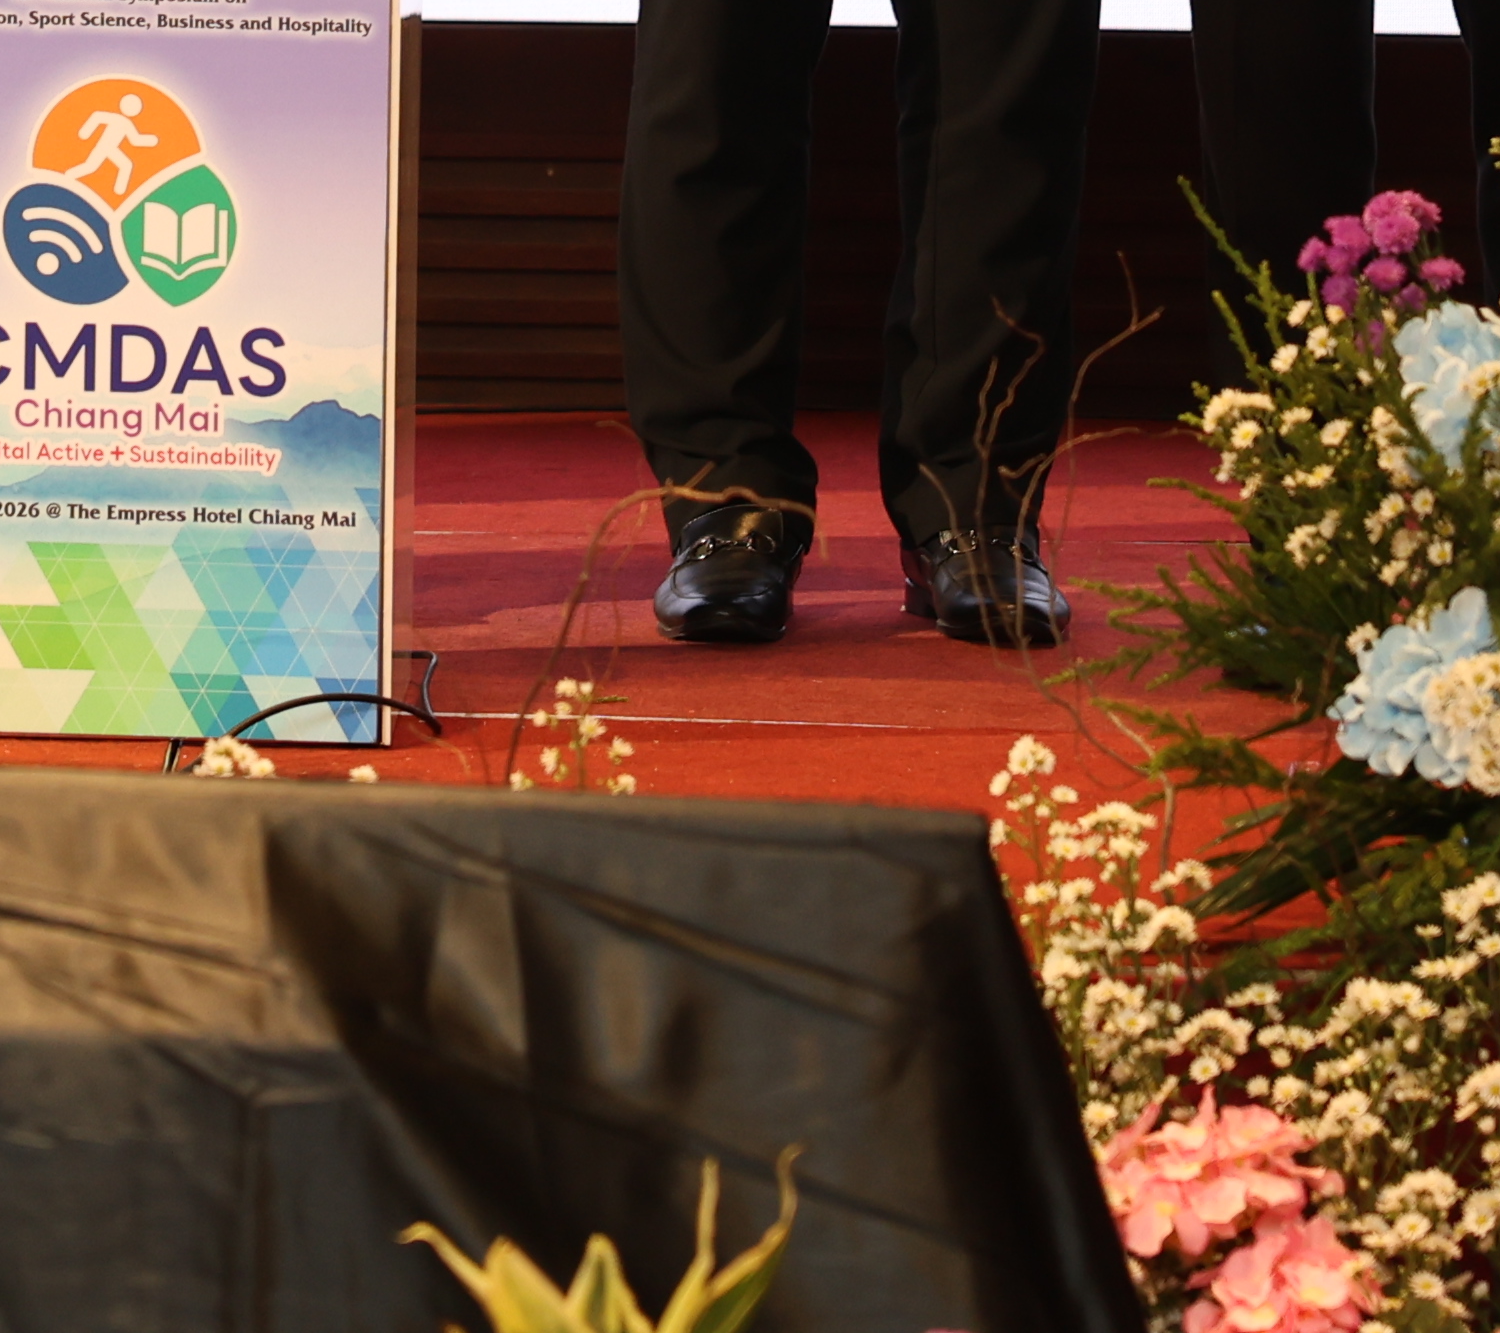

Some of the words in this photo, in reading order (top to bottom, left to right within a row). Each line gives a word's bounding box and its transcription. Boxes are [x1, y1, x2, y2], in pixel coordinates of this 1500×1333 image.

[29, 11, 75, 28] Sport
[80, 12, 151, 30] Science,
[157, 14, 234, 30] Business
[240, 16, 272, 31] and
[278, 17, 372, 37] Hospitality
[15, 398, 143, 438] Chiang
[155, 402, 219, 433] Mai
[37, 443, 104, 462] Active
[130, 446, 276, 472] Sustainability
[46, 502, 61, 519] @
[67, 503, 101, 520] The
[107, 505, 187, 525] Empress
[192, 507, 242, 524] Hotel
[248, 508, 315, 530] Chiang
[320, 511, 356, 527] Mai
